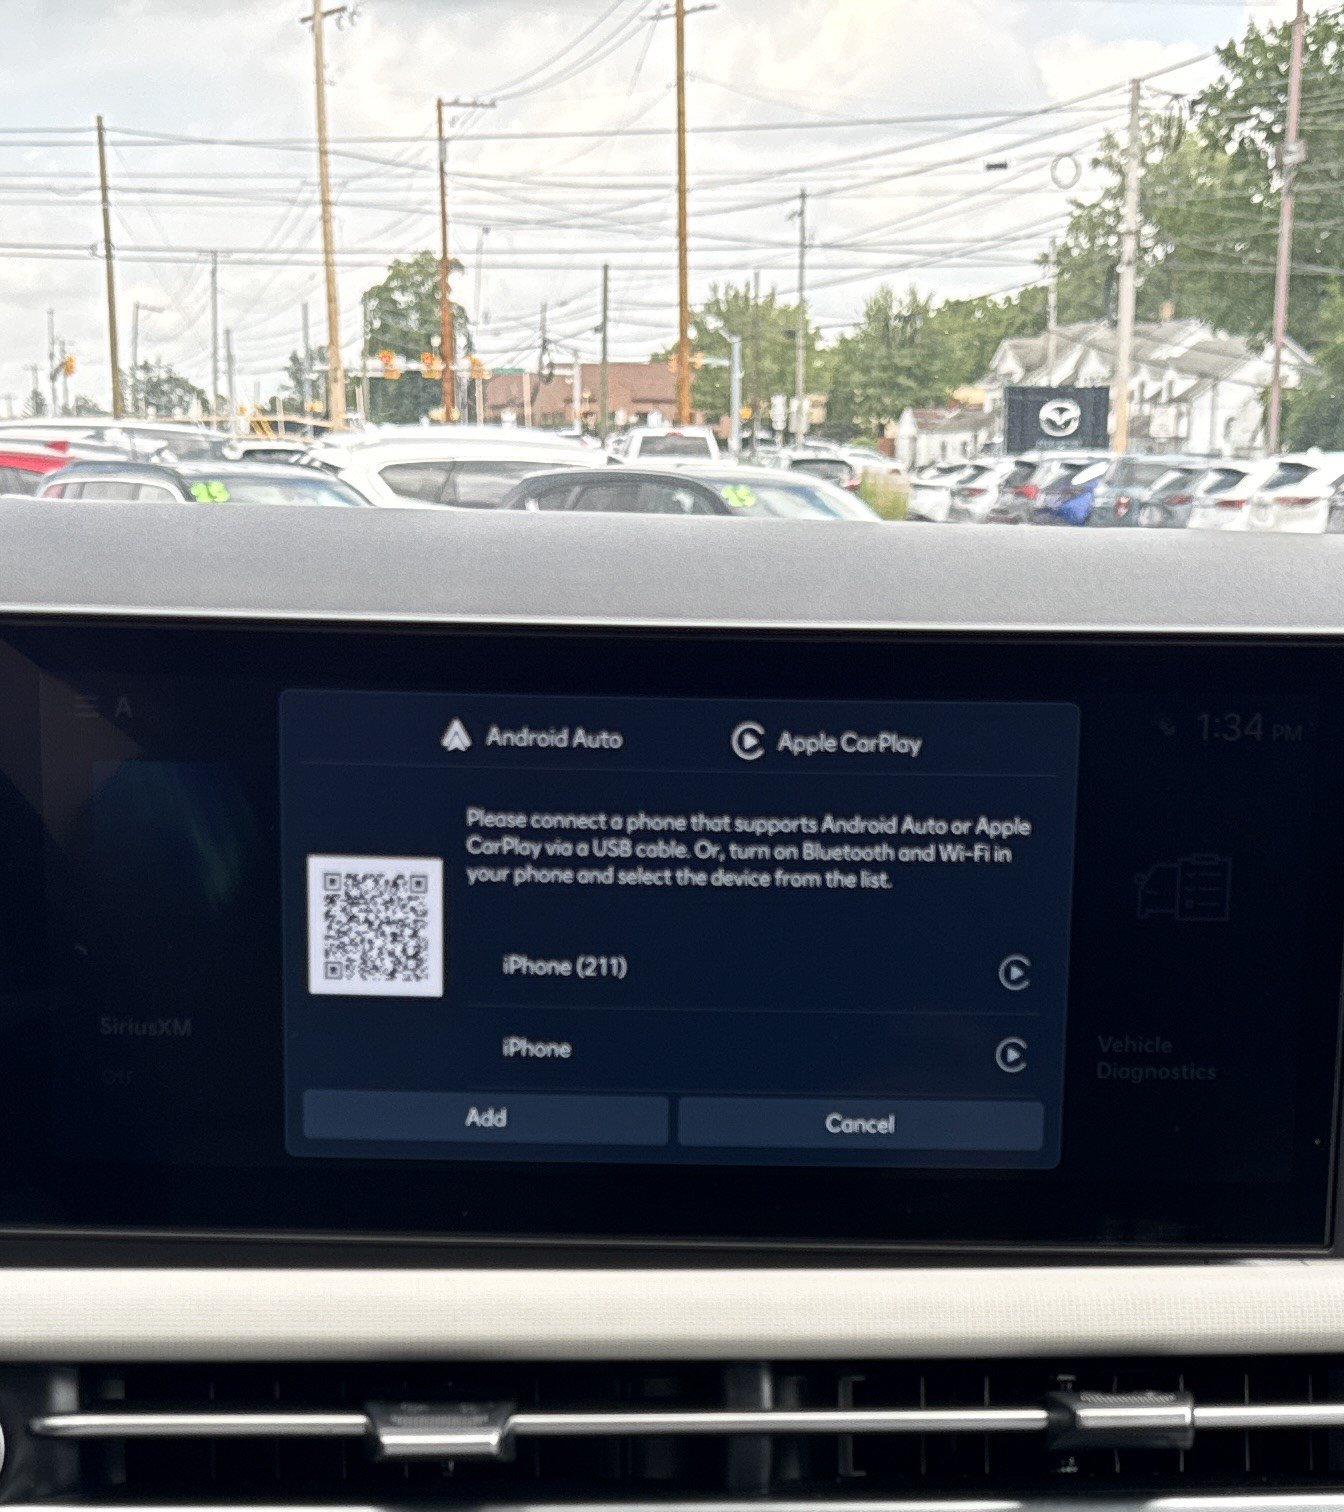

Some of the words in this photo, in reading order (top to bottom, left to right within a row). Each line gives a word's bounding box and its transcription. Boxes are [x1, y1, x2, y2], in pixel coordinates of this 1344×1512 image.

[486, 725, 568, 750] Android
[571, 727, 624, 751] Auto
[1196, 712, 1264, 742] 1:34
[1272, 722, 1304, 742] PM
[777, 730, 837, 757] Apple
[840, 731, 923, 759] CarPlay
[466, 807, 527, 828] Please
[530, 811, 607, 829] connect
[610, 815, 623, 830] a
[625, 811, 687, 834] phone
[690, 812, 731, 832] that
[734, 815, 818, 836] supports
[821, 814, 898, 835] Android
[901, 815, 949, 835] Auto
[950, 819, 972, 836] or
[974, 815, 1031, 839] Apple
[466, 835, 542, 860] CarPlay
[544, 837, 573, 857] via
[575, 842, 589, 857] a
[592, 837, 632, 858] USB
[635, 839, 691, 859] cable.
[693, 839, 726, 862] Or,
[728, 841, 771, 860] turn
[773, 844, 799, 861] on
[802, 841, 896, 862] Bluetooth
[898, 843, 936, 863] and
[938, 844, 991, 863] Wi-Fi
[992, 845, 1013, 864] in
[465, 867, 510, 886] your
[512, 863, 574, 887] phone
[576, 865, 615, 886] and
[617, 866, 672, 887] select
[674, 867, 709, 887] the
[710, 867, 771, 888] device
[773, 867, 822, 889] from
[824, 868, 857, 889] the
[859, 869, 893, 890] list.
[502, 954, 573, 979] iPhone
[576, 955, 628, 980] (211)
[502, 1036, 572, 1061] iPhone
[1097, 1034, 1173, 1054] Vehicle
[1096, 1060, 1217, 1084] Diagnostics
[464, 1106, 508, 1129] Add
[825, 1112, 896, 1137] Cancel
